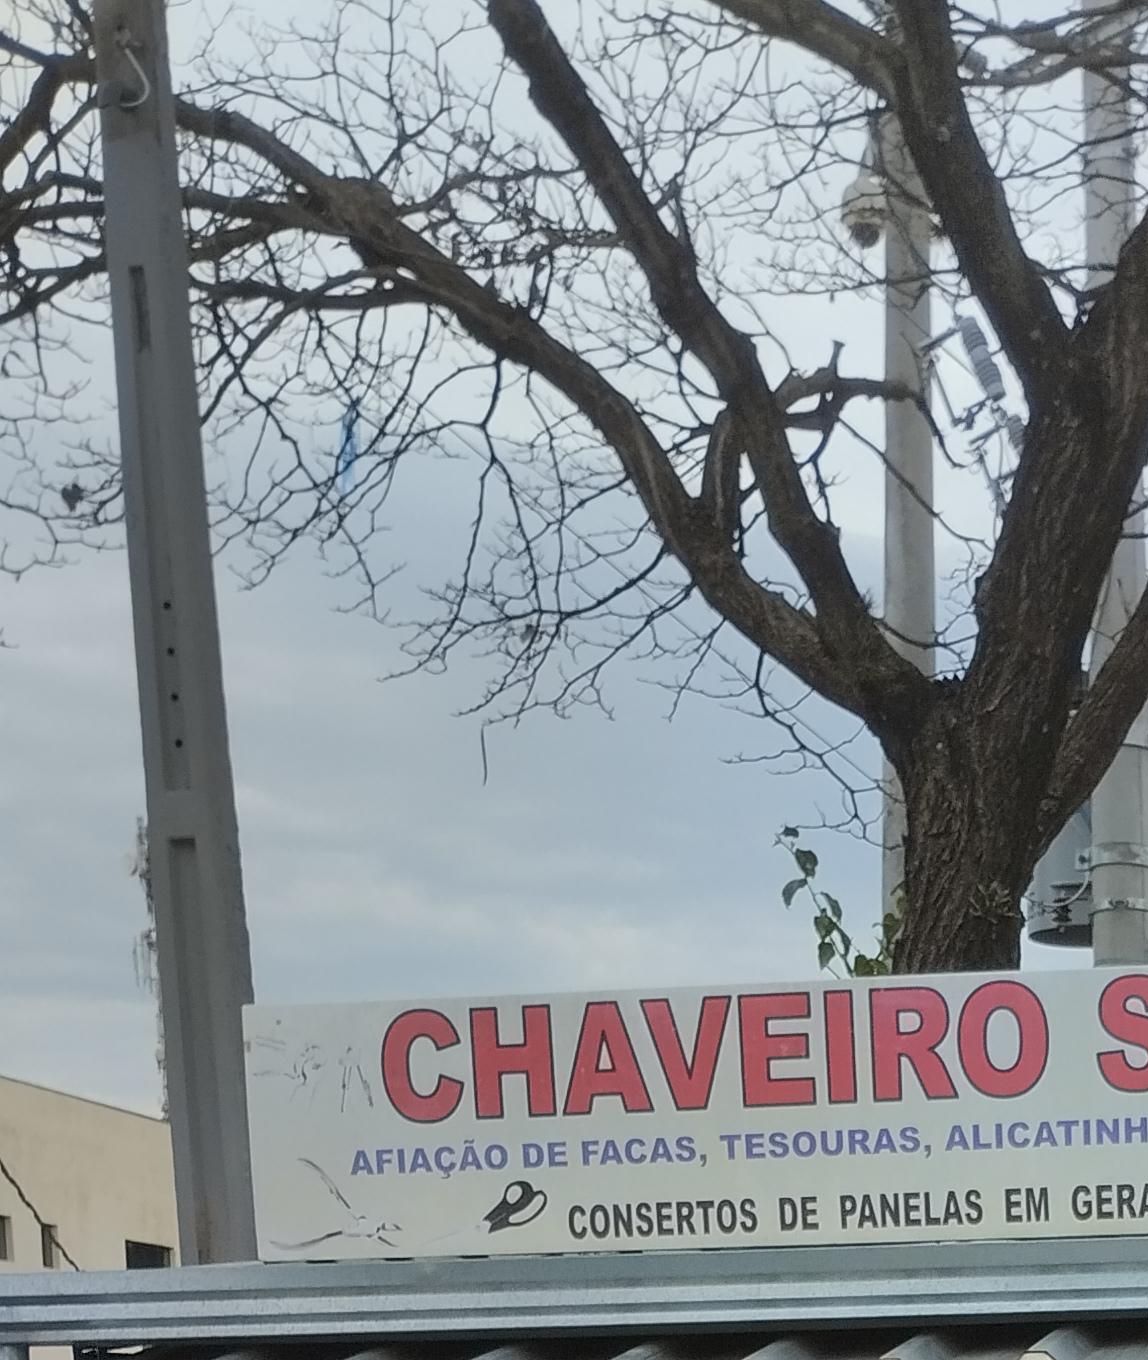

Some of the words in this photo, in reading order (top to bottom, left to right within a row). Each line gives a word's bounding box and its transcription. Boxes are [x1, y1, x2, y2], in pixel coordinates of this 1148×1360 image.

[381, 979, 1049, 1124] CHAVEIRO
[351, 1137, 509, 1179] AFIAÇÃO
[523, 1147, 568, 1170] DE
[582, 1136, 707, 1168] FACAS,
[720, 1126, 932, 1161] TESOURAS,
[568, 1198, 758, 1240] CONSERTOS
[779, 1196, 819, 1233] DE
[840, 1186, 983, 1229] PANELAS
[1005, 1186, 1050, 1225] EM
